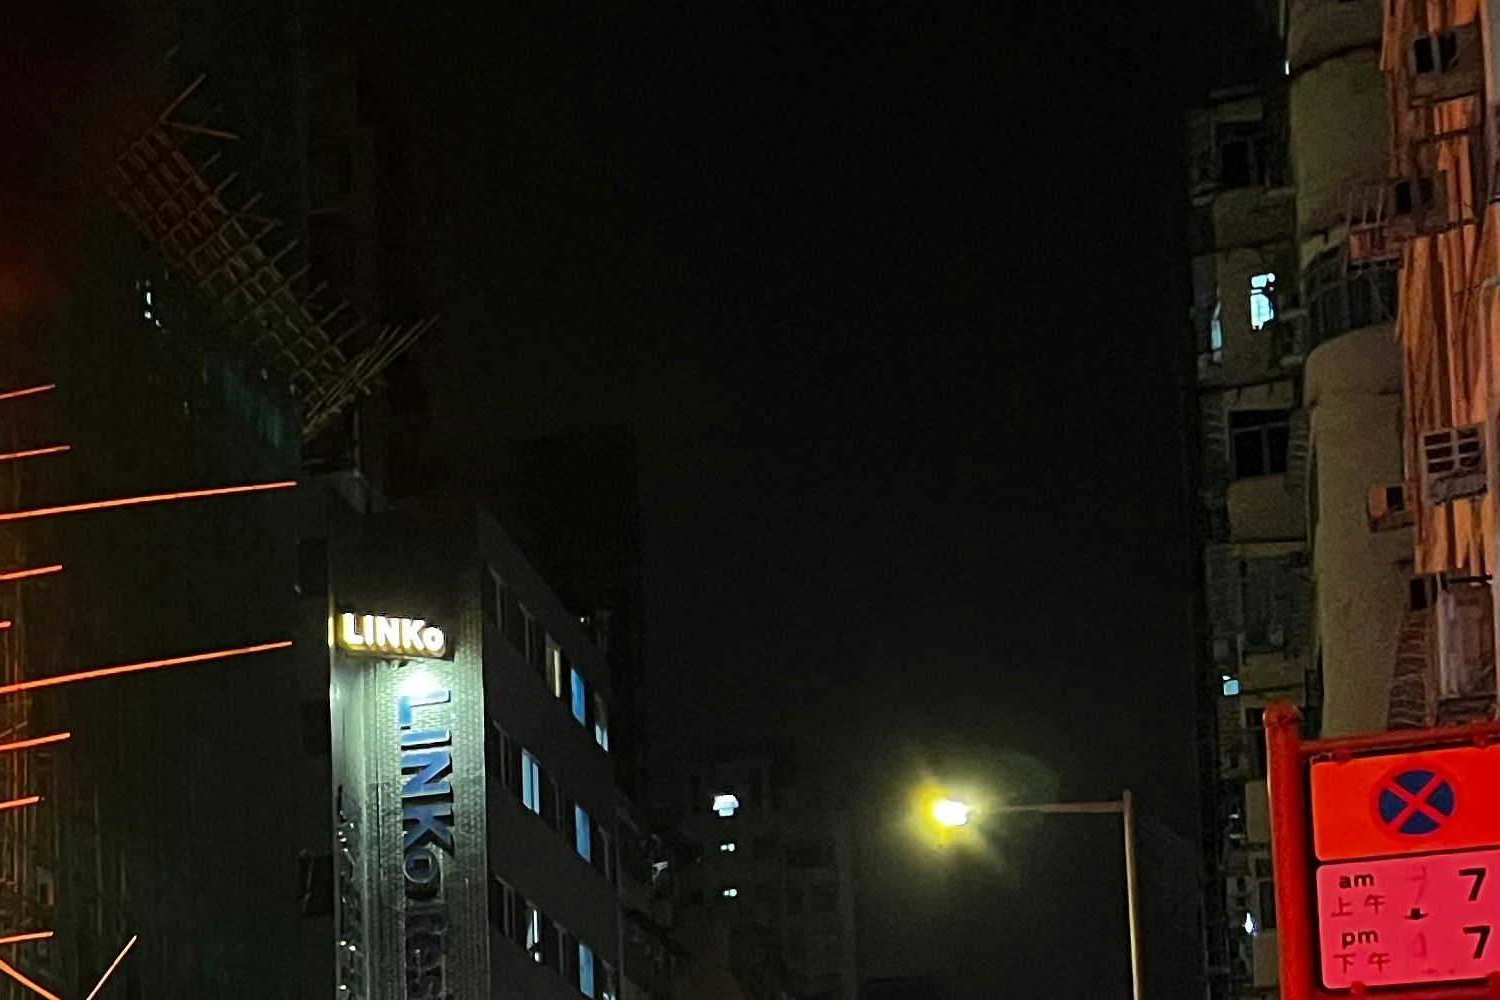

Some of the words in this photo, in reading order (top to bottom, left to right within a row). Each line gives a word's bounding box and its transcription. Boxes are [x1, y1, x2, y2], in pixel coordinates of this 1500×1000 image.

[1339, 873, 1374, 889] am
[1458, 868, 1487, 901] 7
[1331, 895, 1386, 917] 上午
[1341, 930, 1378, 949] pm
[1463, 925, 1491, 959] 7
[1333, 952, 1391, 973] 下午
